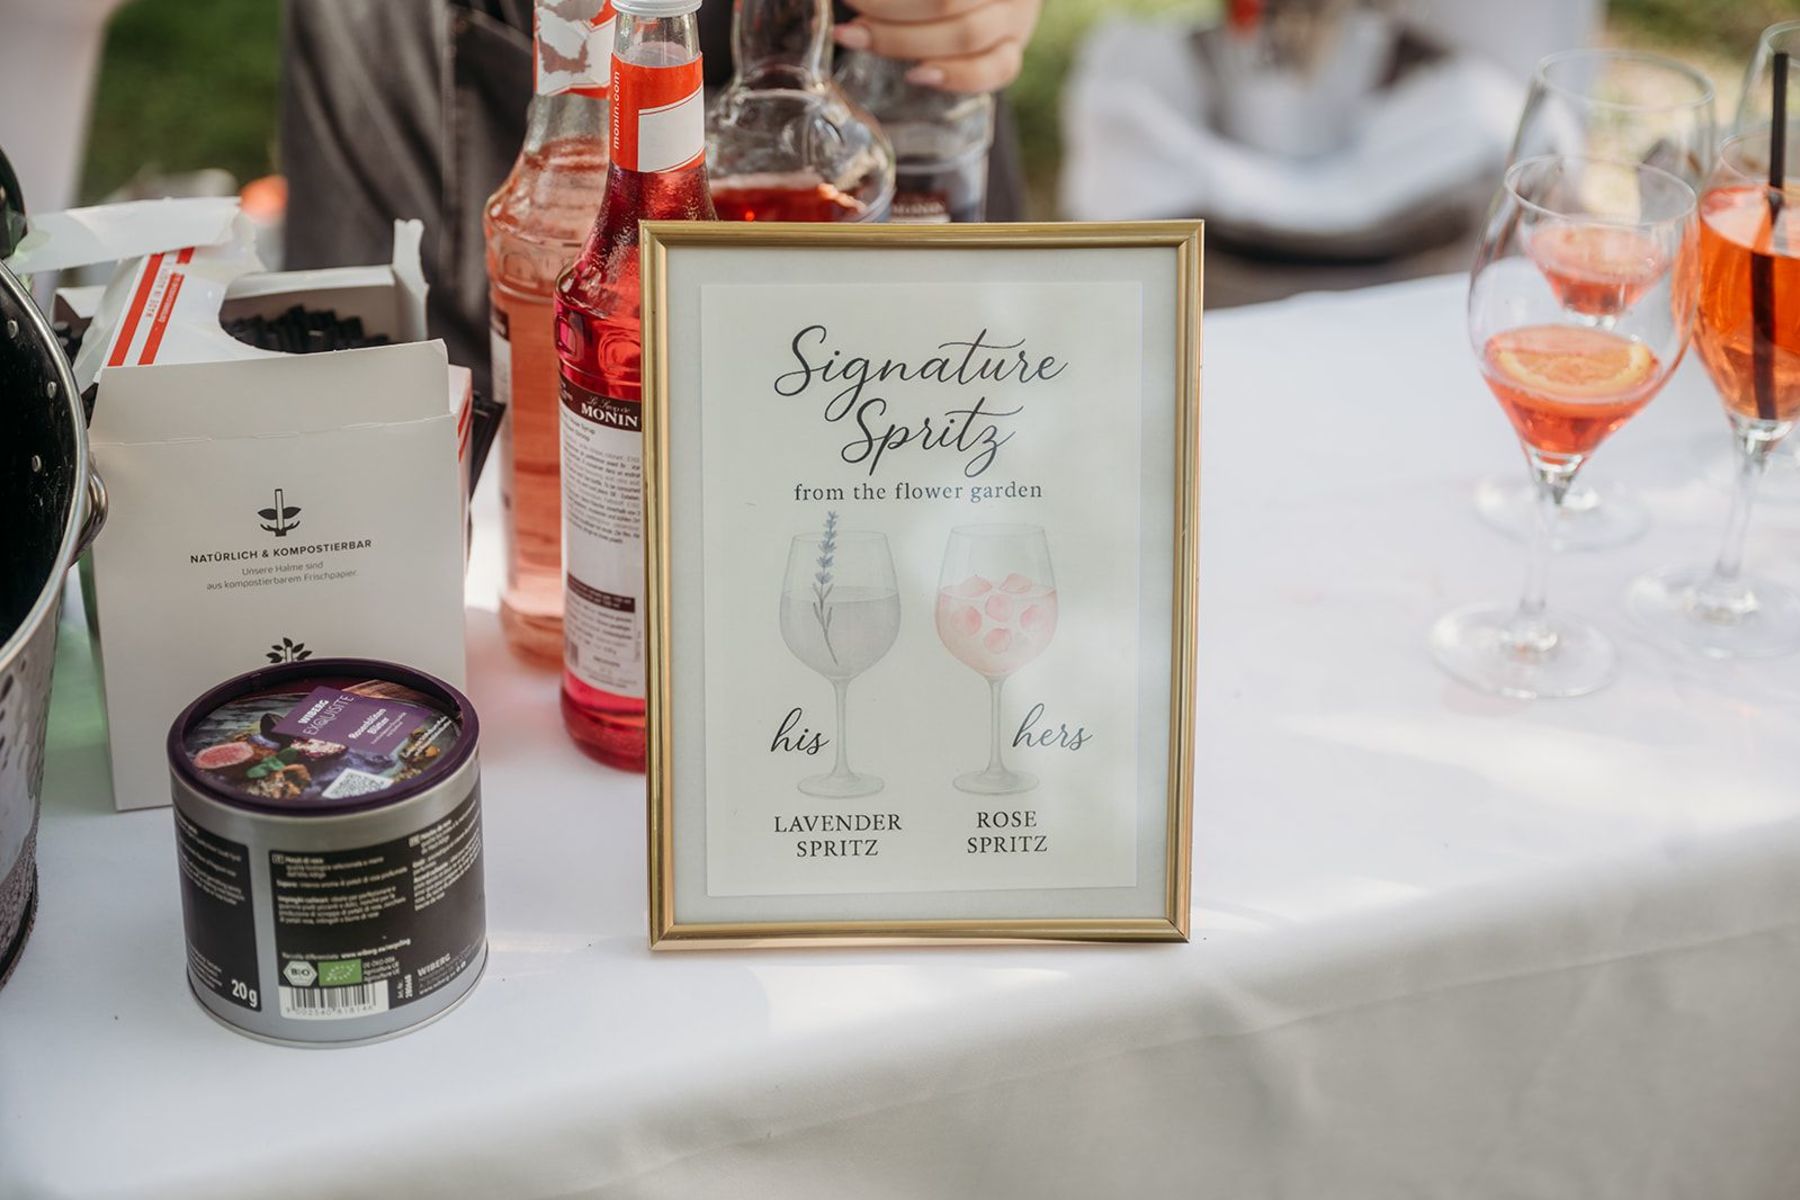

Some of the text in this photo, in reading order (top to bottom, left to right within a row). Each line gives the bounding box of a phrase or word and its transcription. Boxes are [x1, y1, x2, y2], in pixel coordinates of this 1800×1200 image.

[774, 325, 1068, 422] Signature
[581, 402, 638, 427] MONIN
[841, 396, 1024, 478] Spritz
[794, 481, 1042, 503] from the flower garden
[190, 539, 372, 563] NATÜRLICH & KOMPOSTIERBAR
[241, 561, 324, 576] Unsere Halme sind
[206, 582, 223, 591] aus
[224, 574, 302, 589] kompostierbarem
[298, 699, 330, 724] WIBERG
[302, 695, 355, 736] EXQUISITE
[770, 707, 830, 755] his
[1012, 702, 1093, 751] hers
[774, 813, 903, 832] LAVENDER
[976, 811, 1038, 828] ROSE
[796, 839, 880, 857] SPRITZ
[967, 835, 1048, 853] SPRITZ
[417, 953, 452, 977] WIBERG
